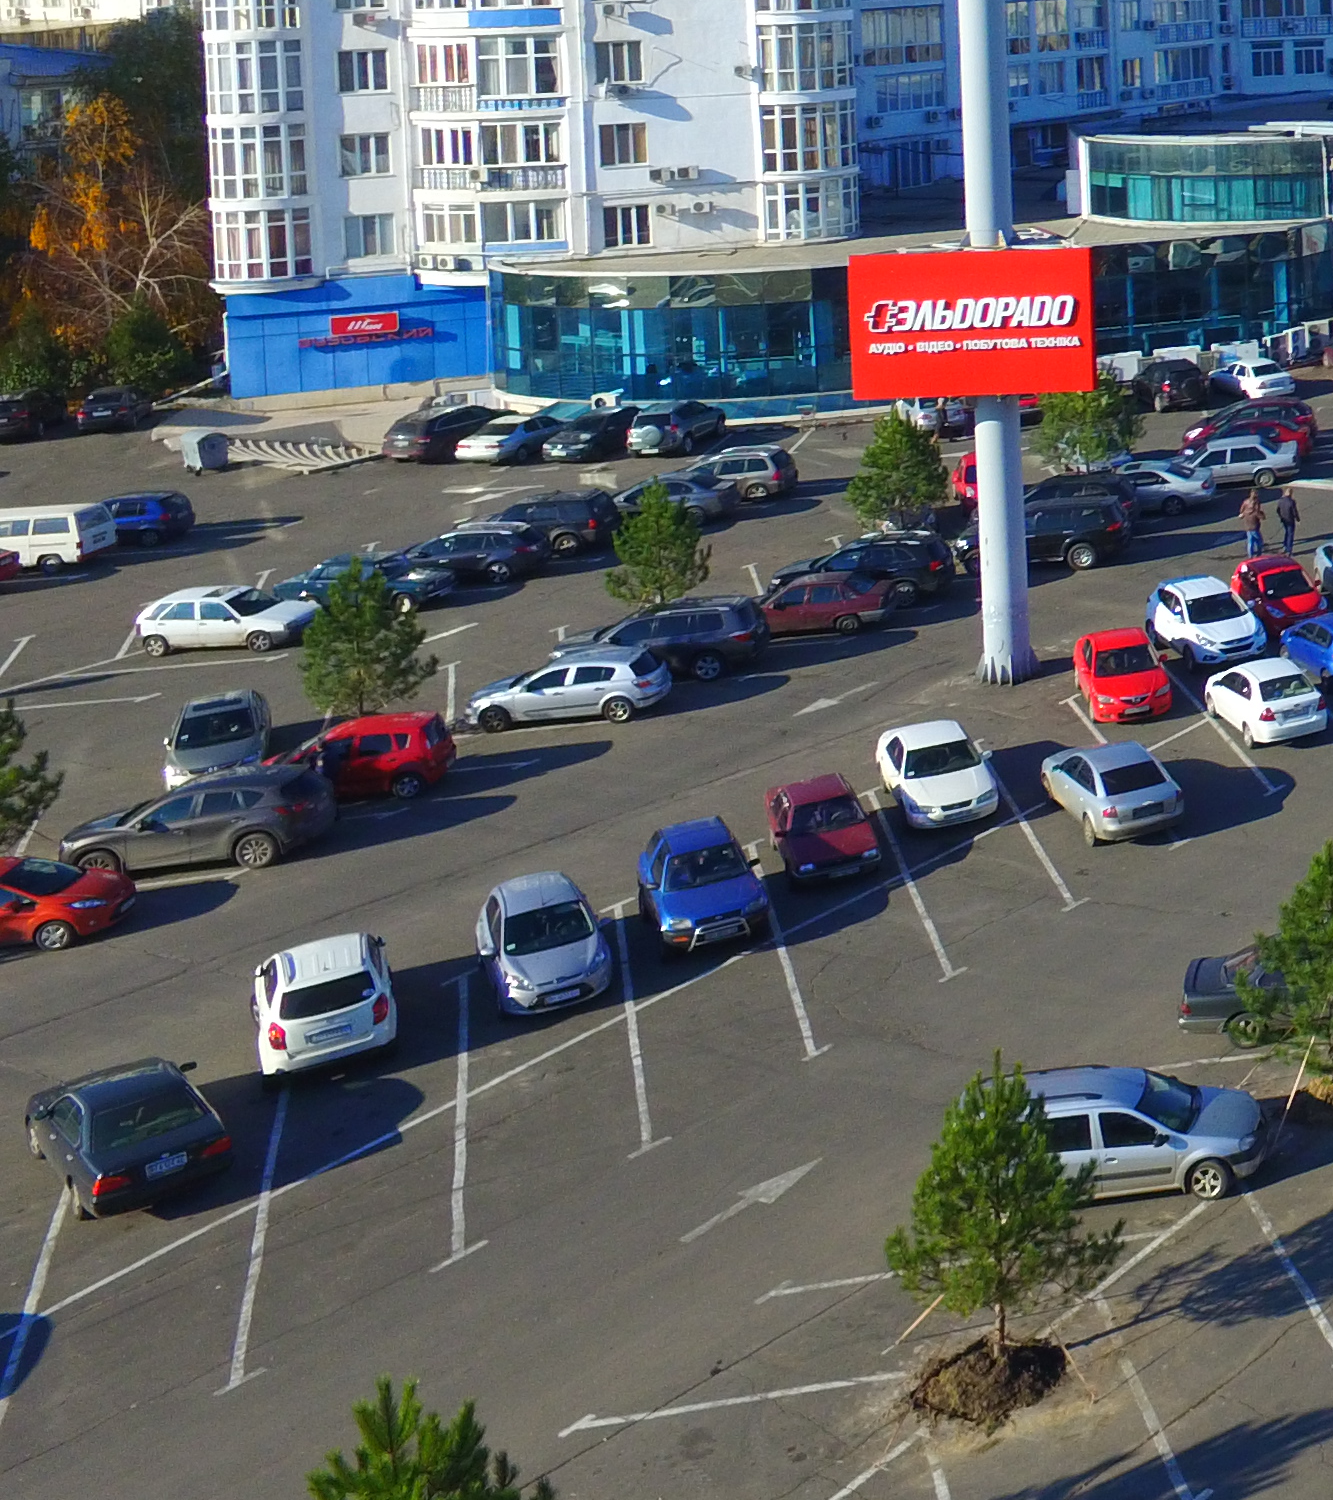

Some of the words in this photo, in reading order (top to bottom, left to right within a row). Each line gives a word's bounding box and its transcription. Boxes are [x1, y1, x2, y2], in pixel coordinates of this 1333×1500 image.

[868, 342, 906, 356] АУДІО
[916, 340, 954, 354] ВІДЕО
[962, 337, 1028, 352] ПОБУТОВА
[1029, 335, 1081, 349] ТЕХНІКА
